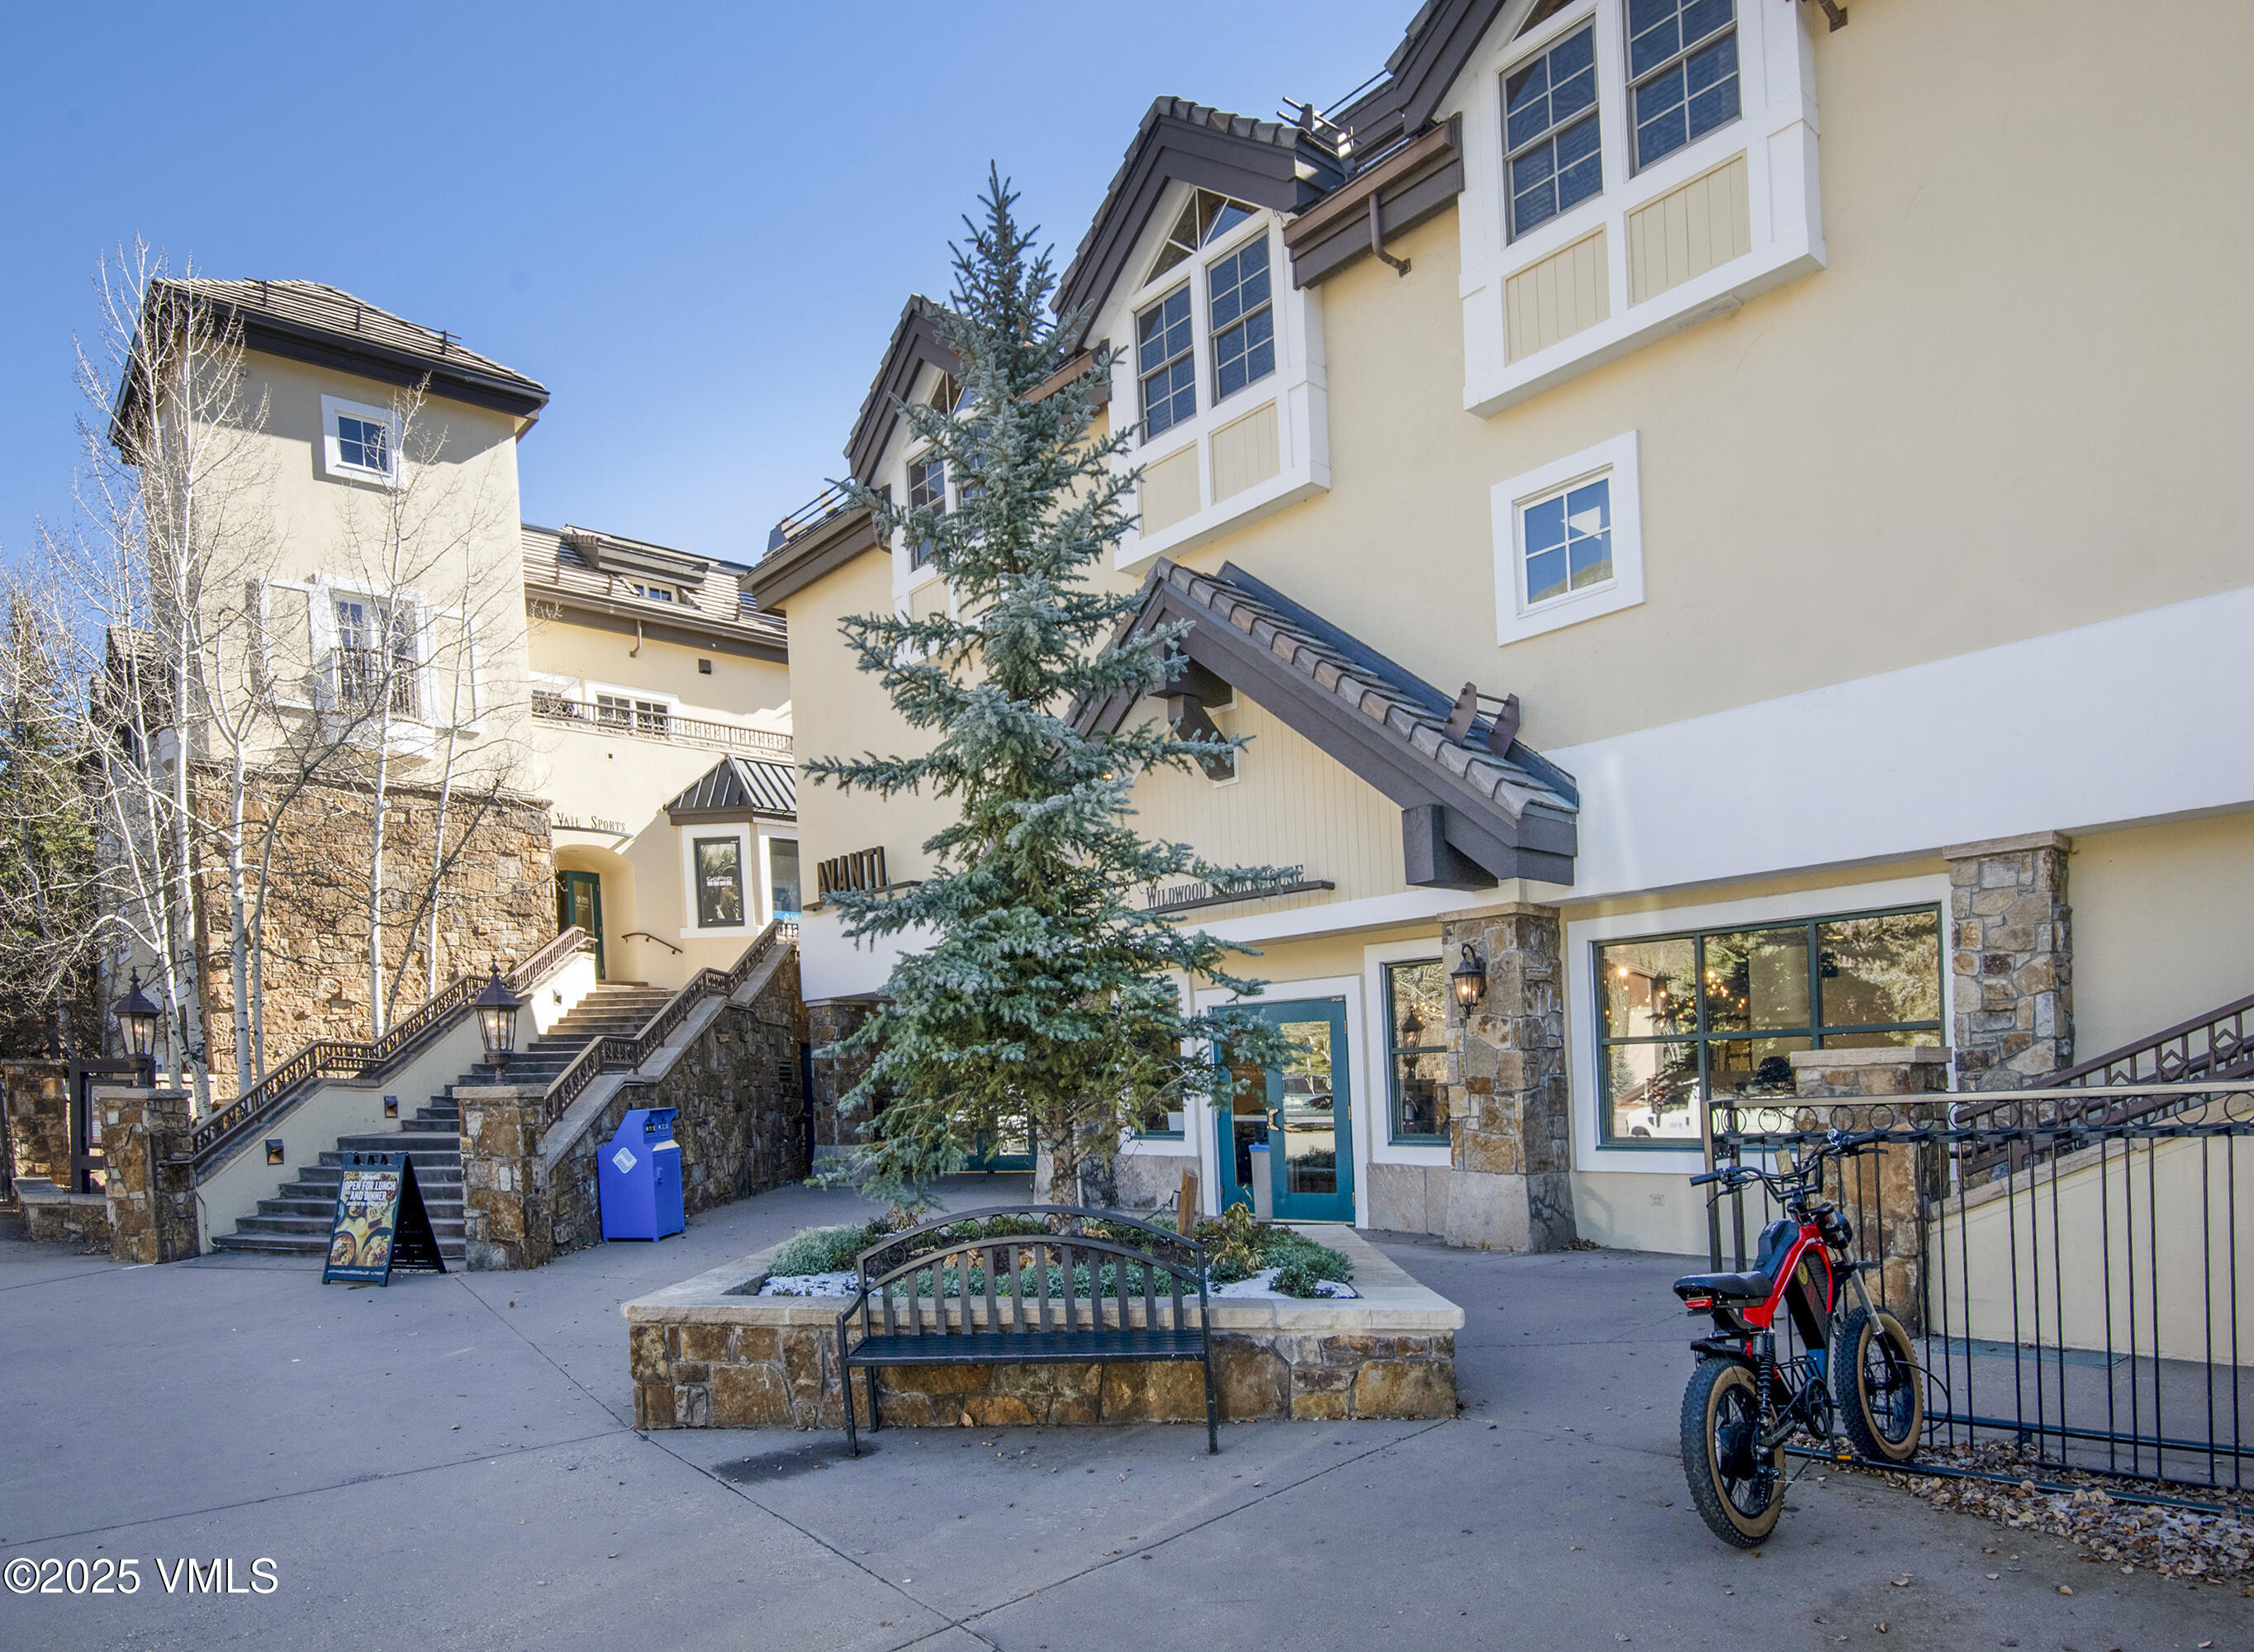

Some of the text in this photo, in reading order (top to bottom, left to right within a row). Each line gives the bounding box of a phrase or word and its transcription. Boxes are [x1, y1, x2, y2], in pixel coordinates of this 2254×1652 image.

[555, 812, 626, 832] VAIL SPORTS
[817, 846, 887, 901] AVANTI
[1146, 882, 1207, 909] WILDWOOD
[344, 1180, 396, 1191] OPEN FOR LUNCH
[349, 1190, 387, 1201] AND DINNER
